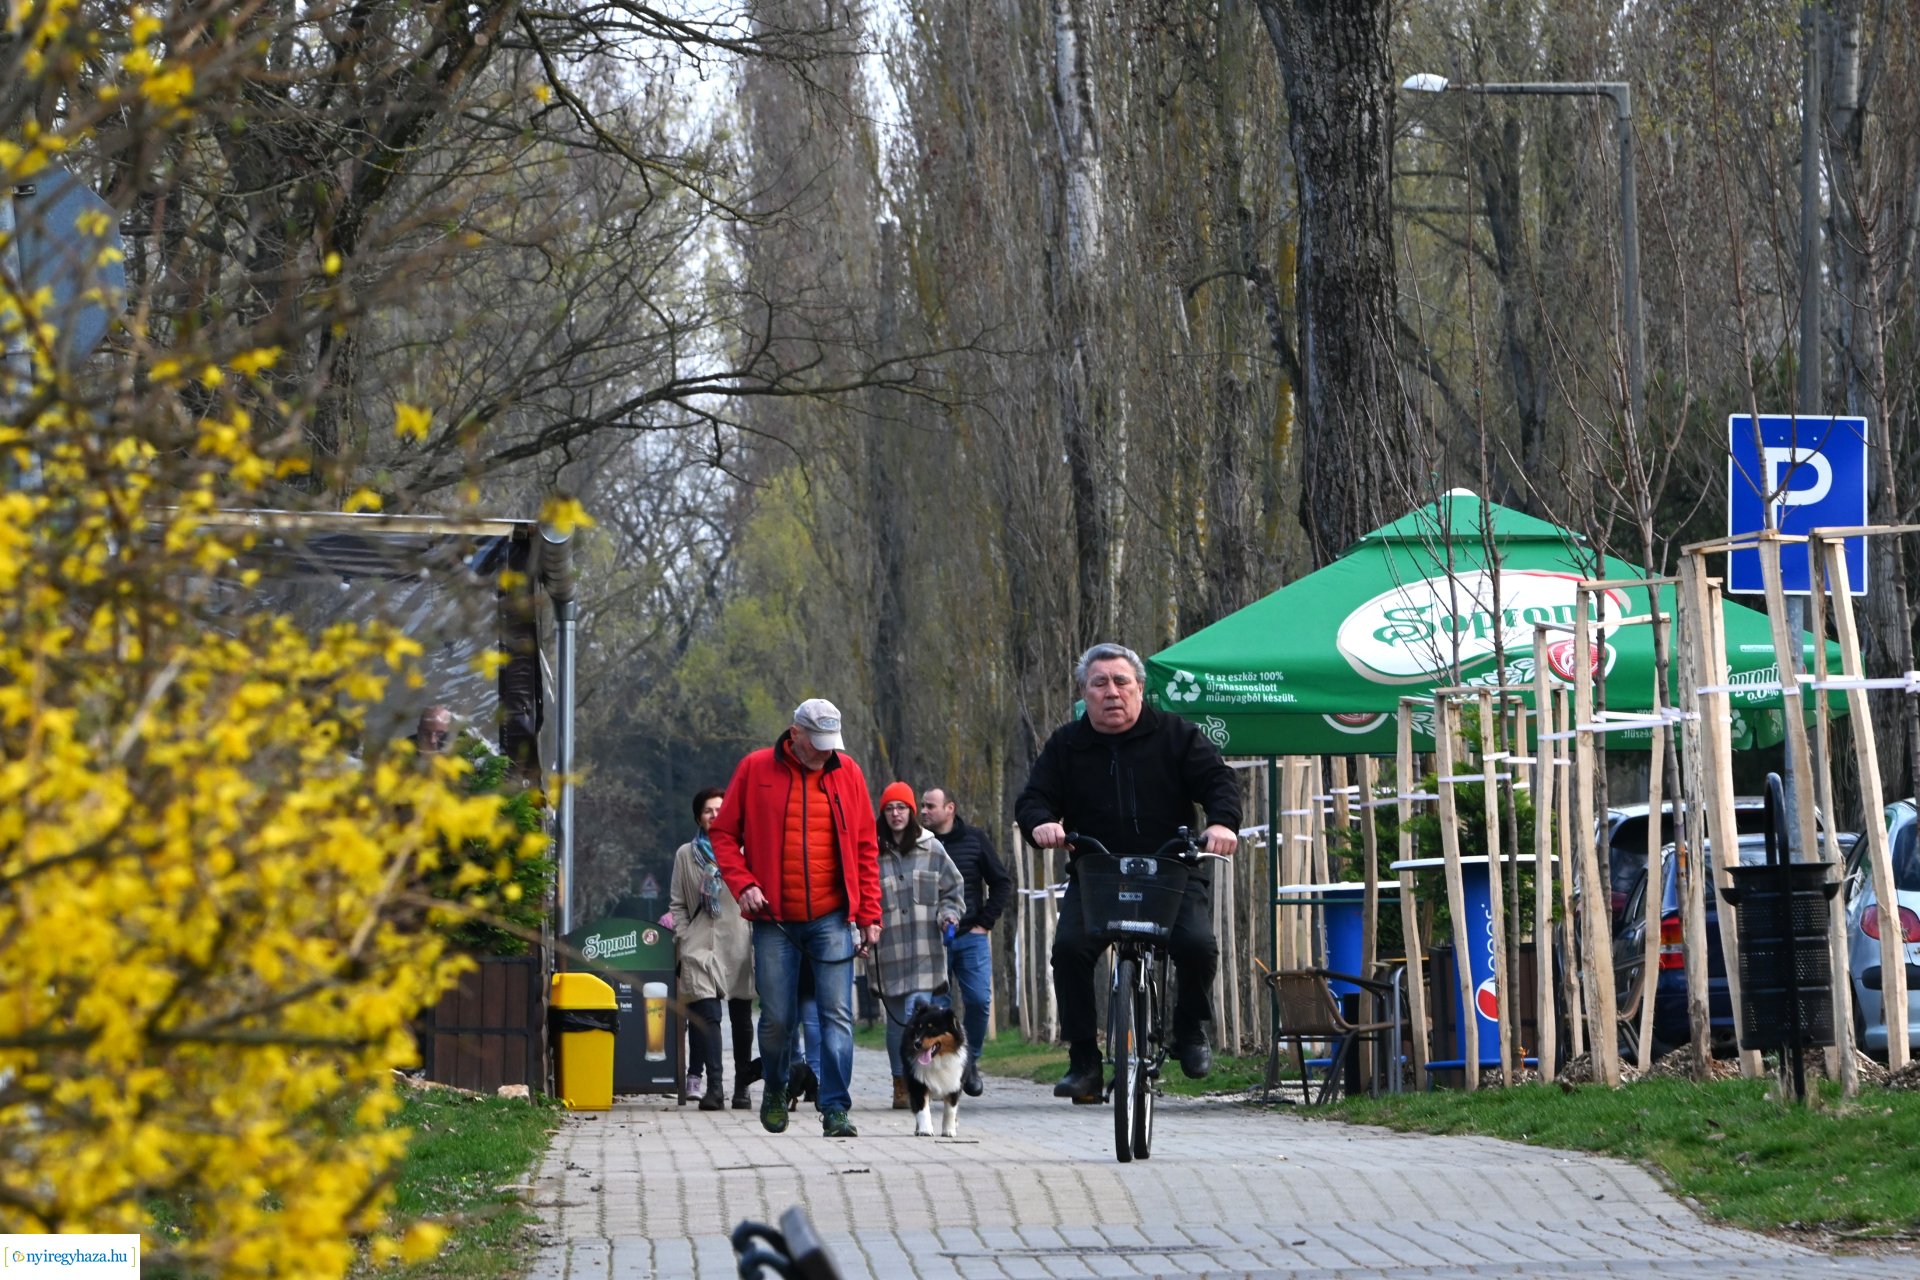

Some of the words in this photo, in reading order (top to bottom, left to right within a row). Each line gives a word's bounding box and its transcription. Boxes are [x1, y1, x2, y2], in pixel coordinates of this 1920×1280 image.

[1763, 447, 1833, 531] P
[1228, 672, 1257, 682] eszköz
[1260, 671, 1284, 681] 100%
[1727, 662, 1781, 698] oproni
[1206, 693, 1261, 704] műanyagból
[1263, 693, 1298, 703] készült.
[582, 930, 637, 961] Soproni
